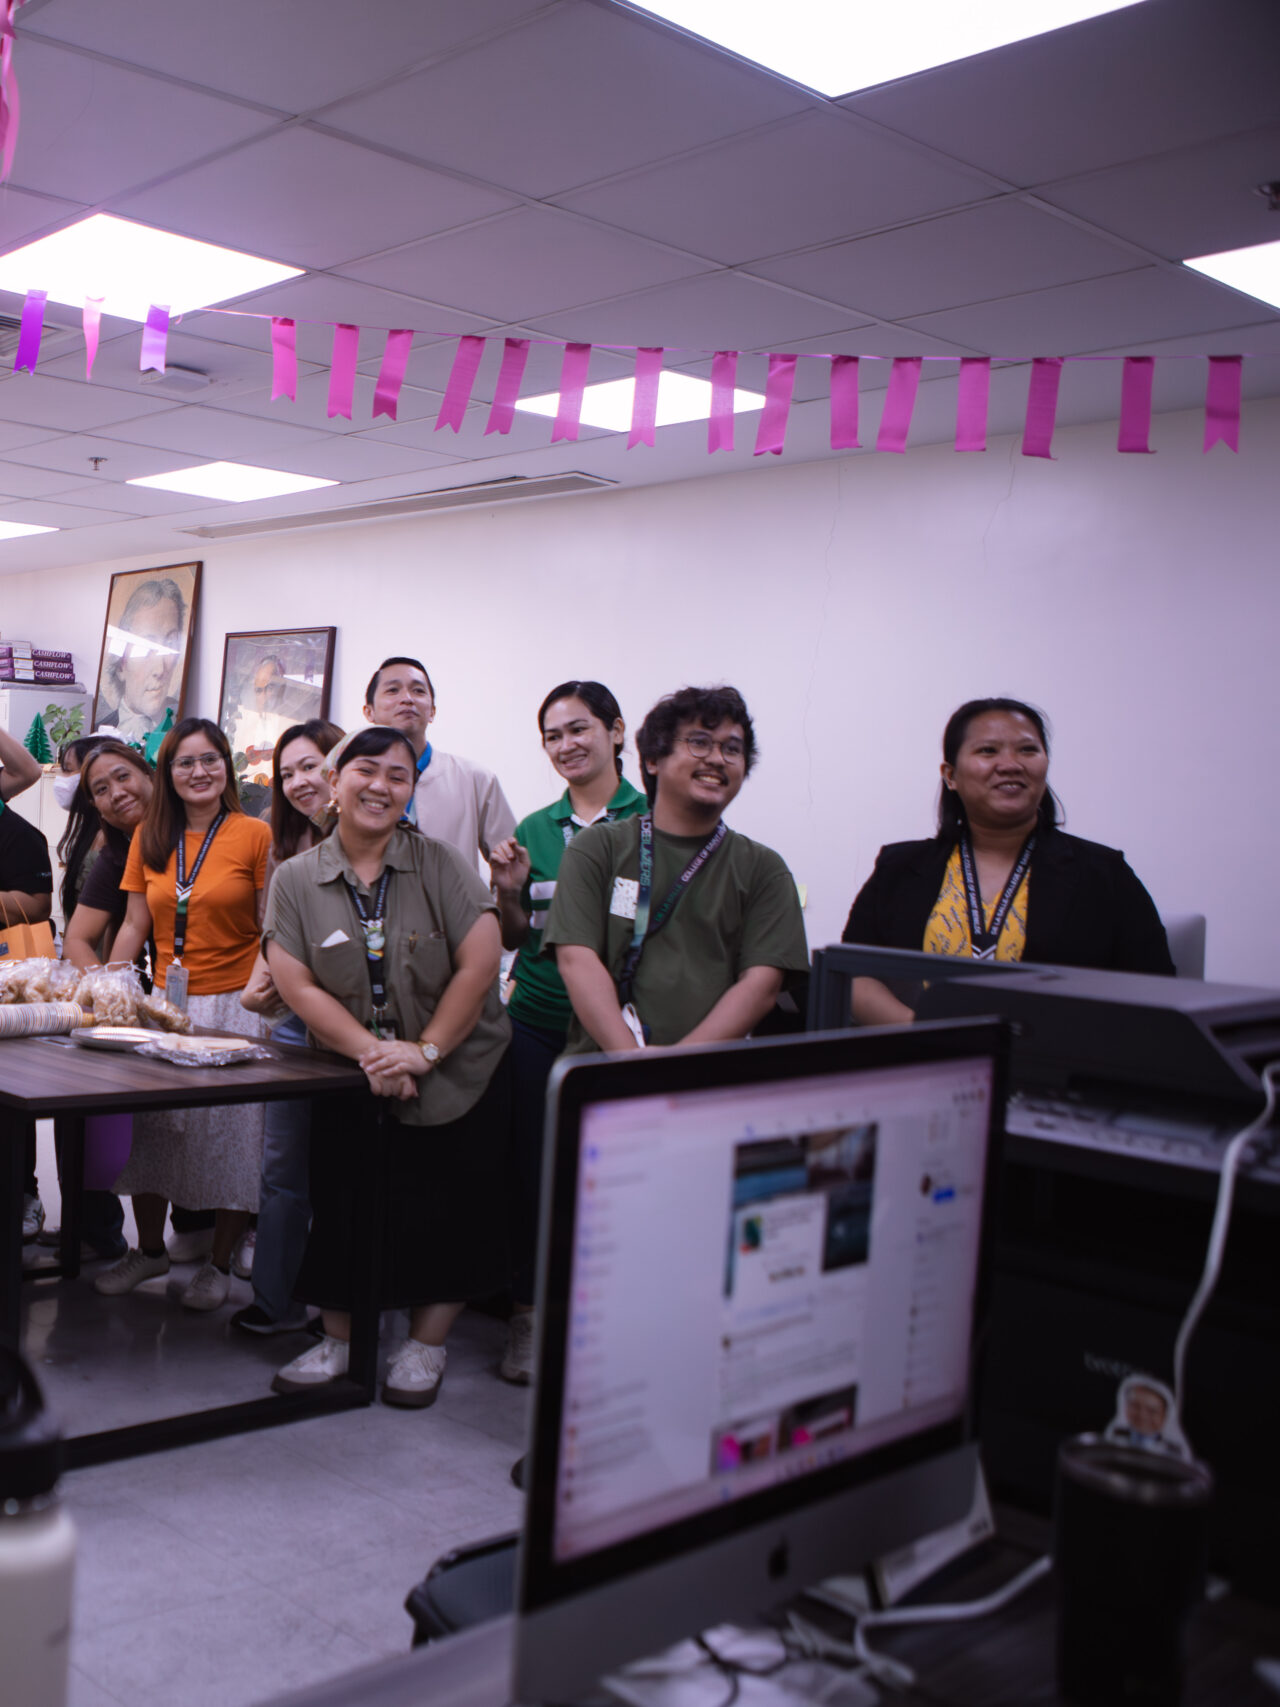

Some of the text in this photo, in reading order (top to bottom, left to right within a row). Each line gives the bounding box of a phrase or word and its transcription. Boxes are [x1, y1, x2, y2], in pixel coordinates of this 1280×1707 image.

[32, 650, 68, 659] CASHFLOW
[34, 660, 70, 669] CASHFLOW
[35, 670, 72, 679] CASHFLOW
